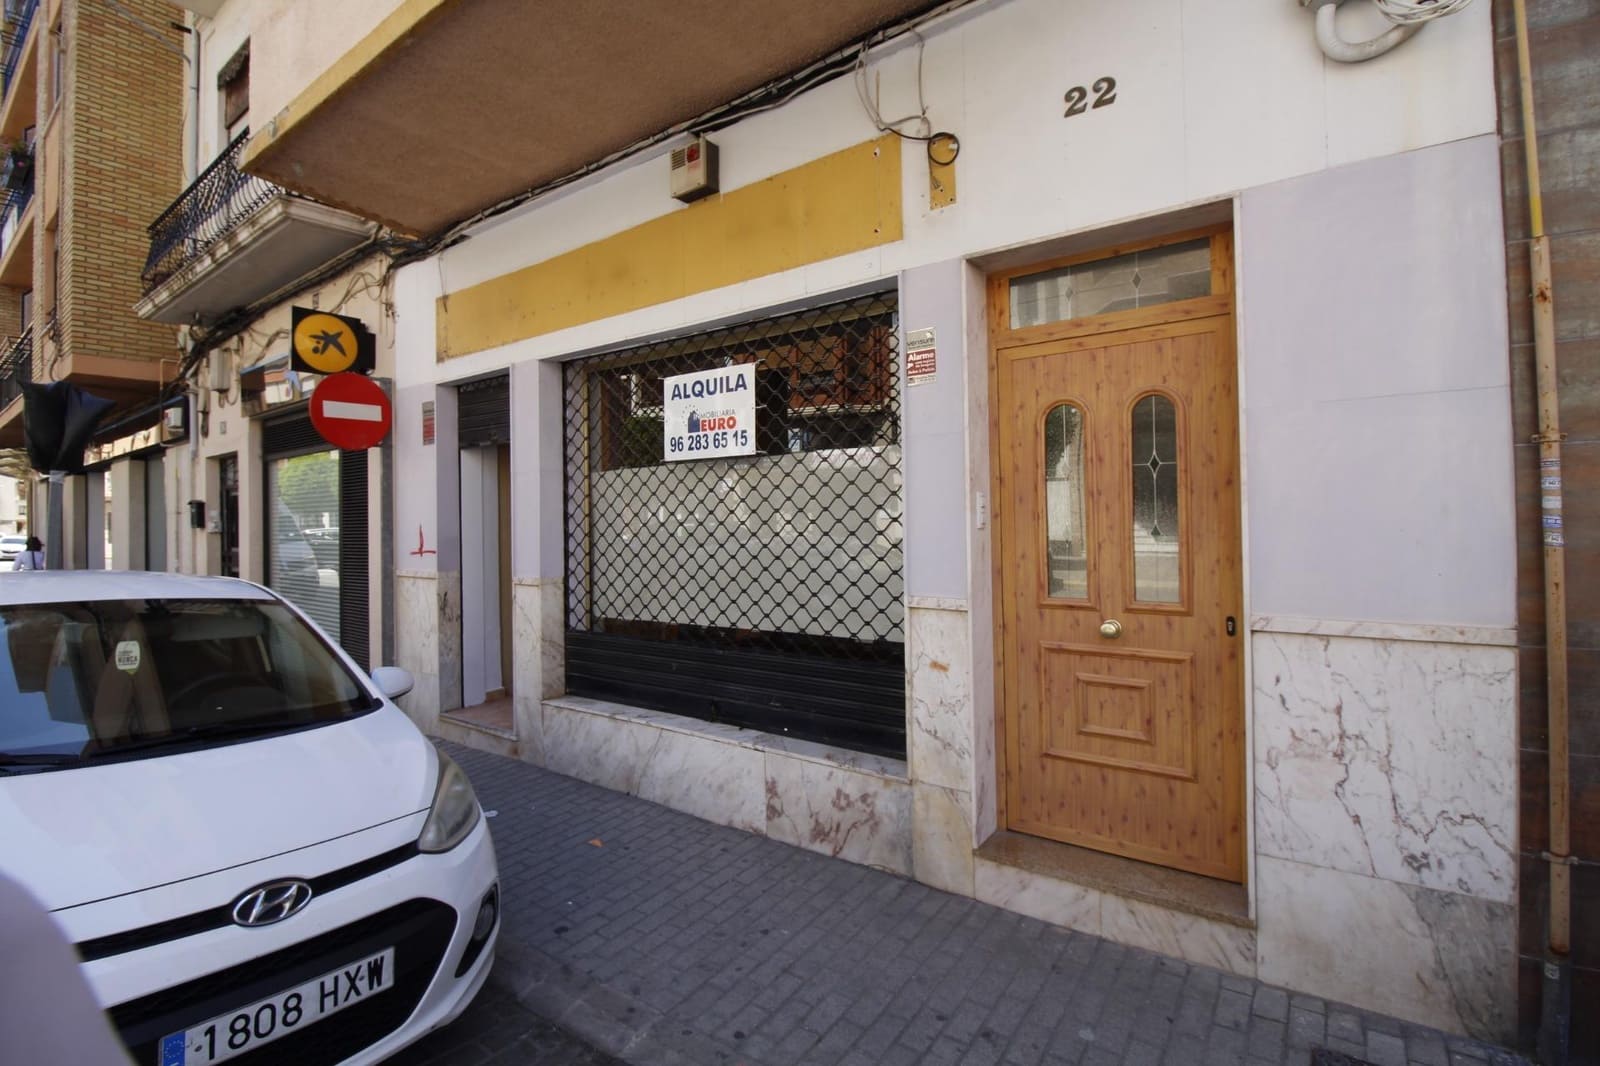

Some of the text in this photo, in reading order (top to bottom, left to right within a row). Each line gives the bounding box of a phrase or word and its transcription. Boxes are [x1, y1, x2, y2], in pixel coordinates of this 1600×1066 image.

[1063, 76, 1117, 118] 22
[671, 373, 748, 400] ALQUILA
[700, 416, 737, 432] EURO
[670, 429, 748, 453] 96 283 65 15
[204, 955, 385, 1061] 1808 HXW
